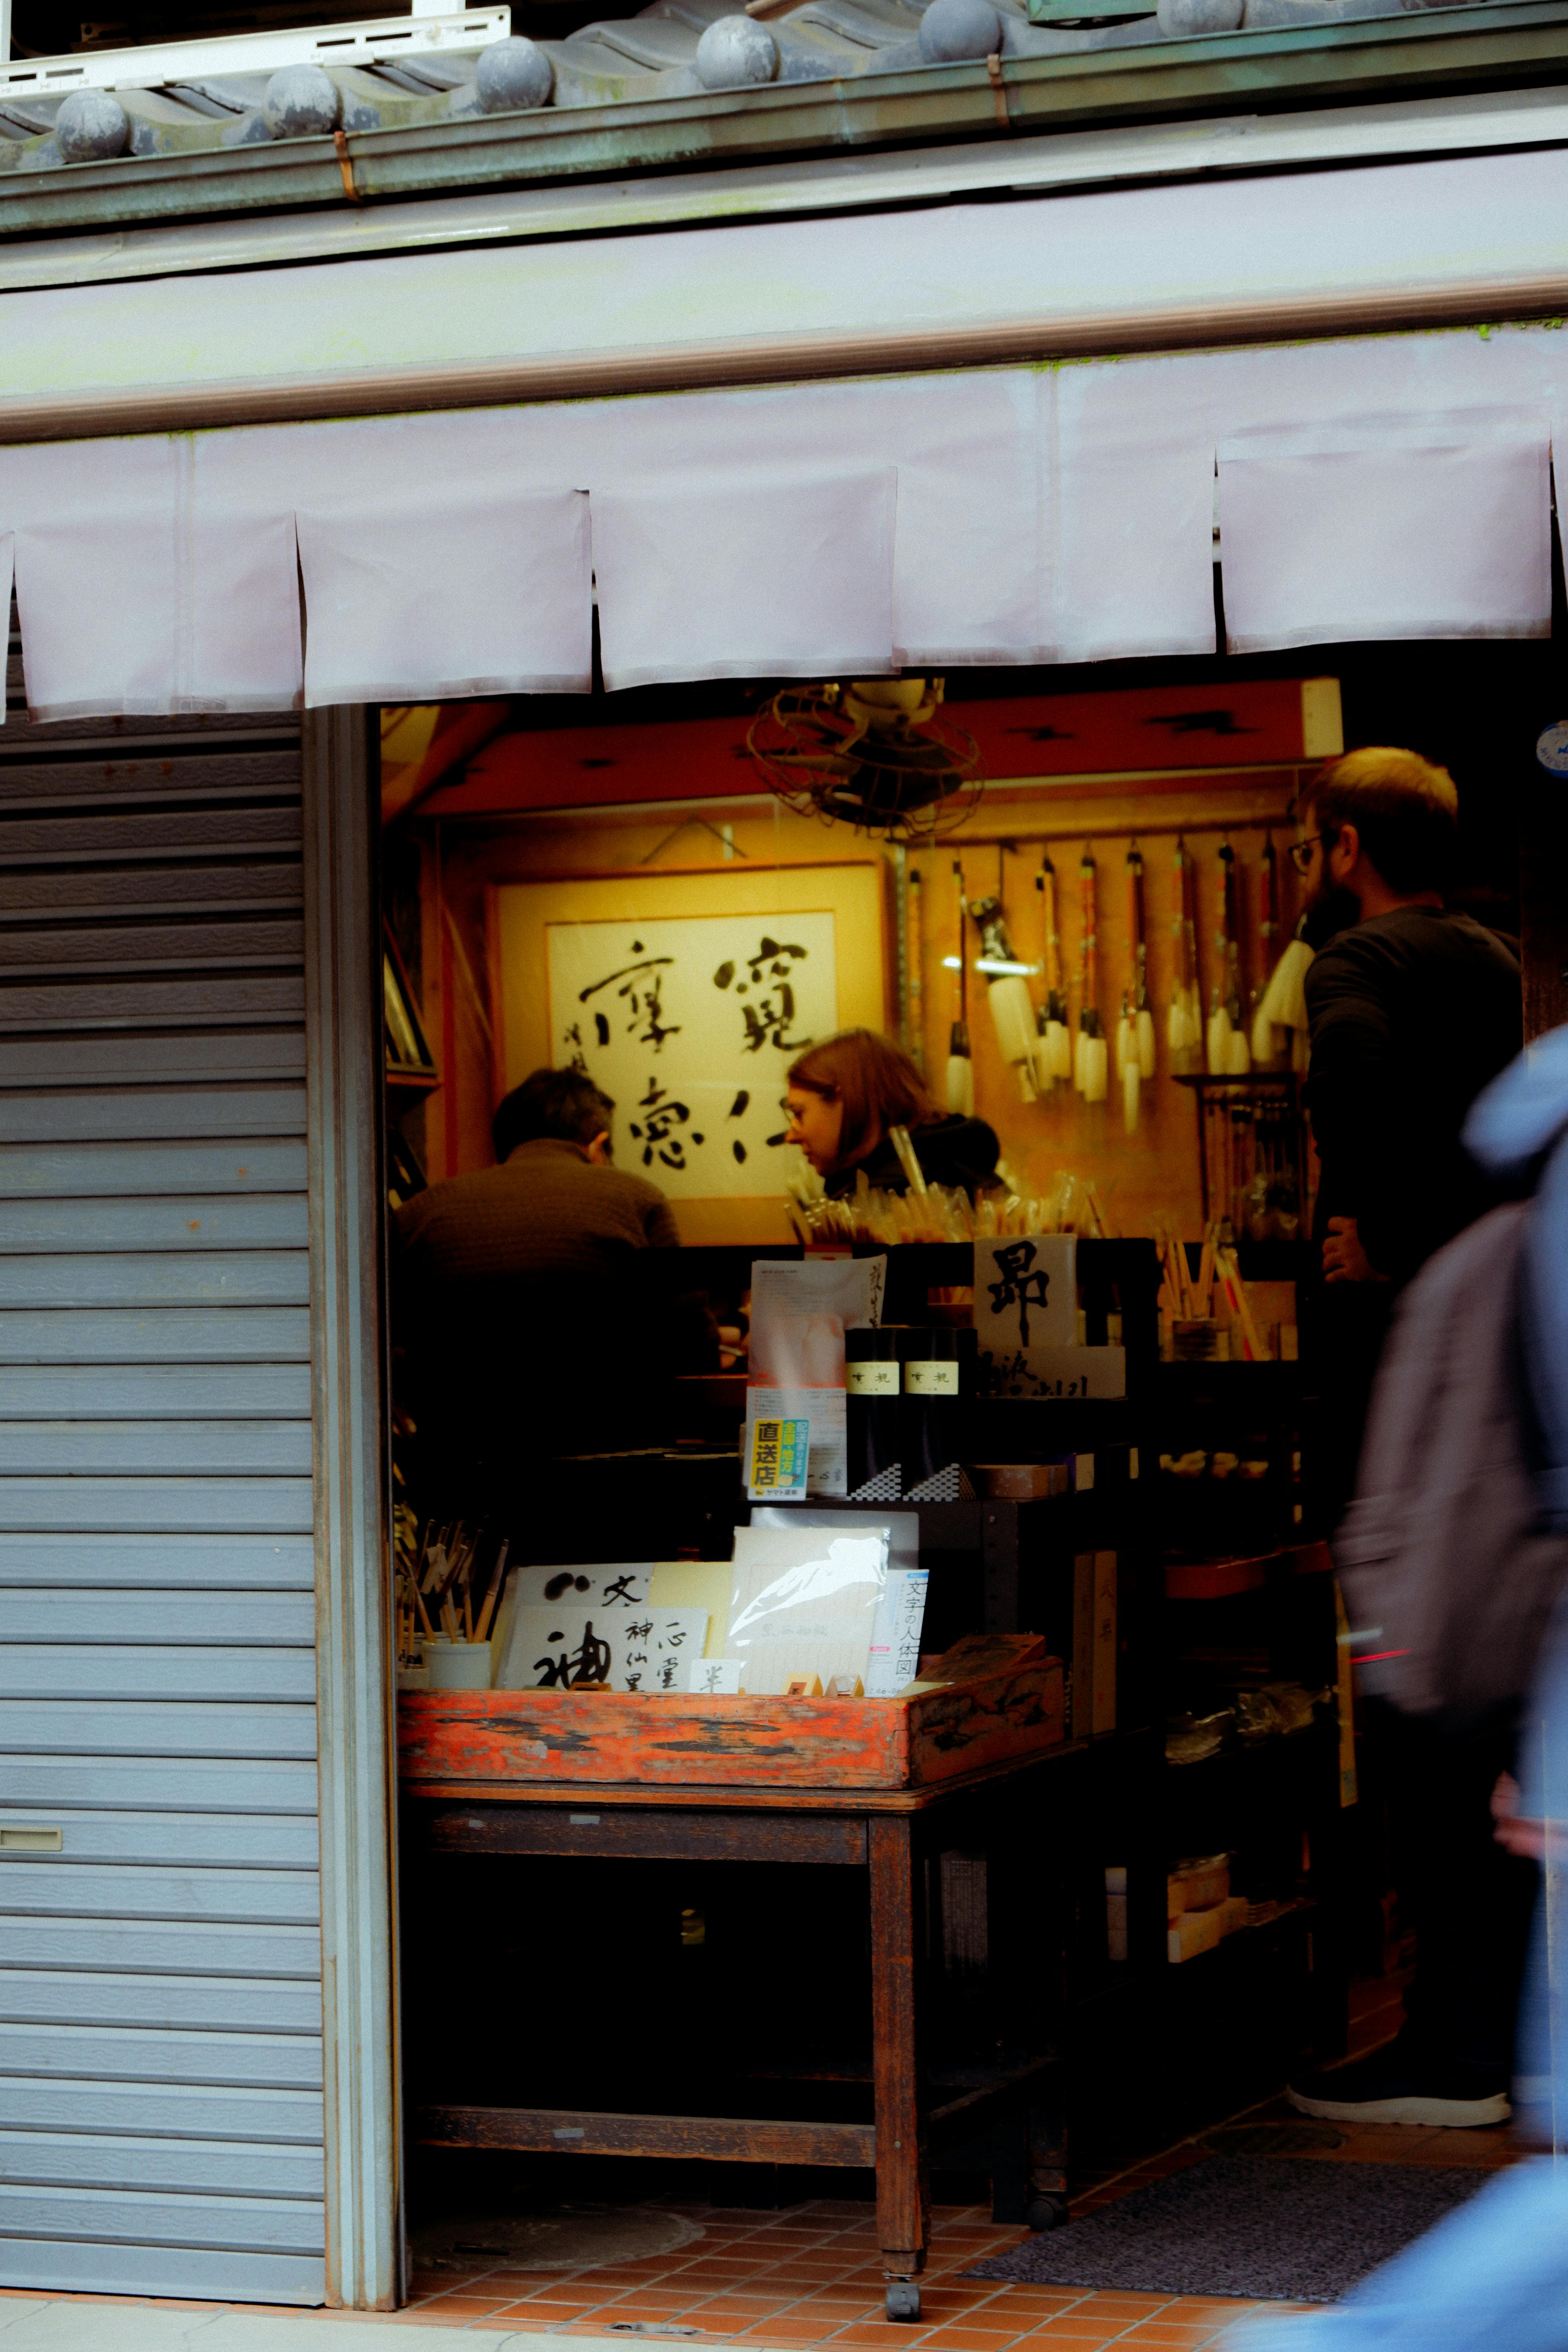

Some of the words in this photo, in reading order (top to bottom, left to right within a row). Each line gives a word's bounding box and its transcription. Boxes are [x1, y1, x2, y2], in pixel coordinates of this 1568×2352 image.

[754, 1423, 780, 1486] 直送店
[896, 1580, 927, 1675] 文字の人体図
